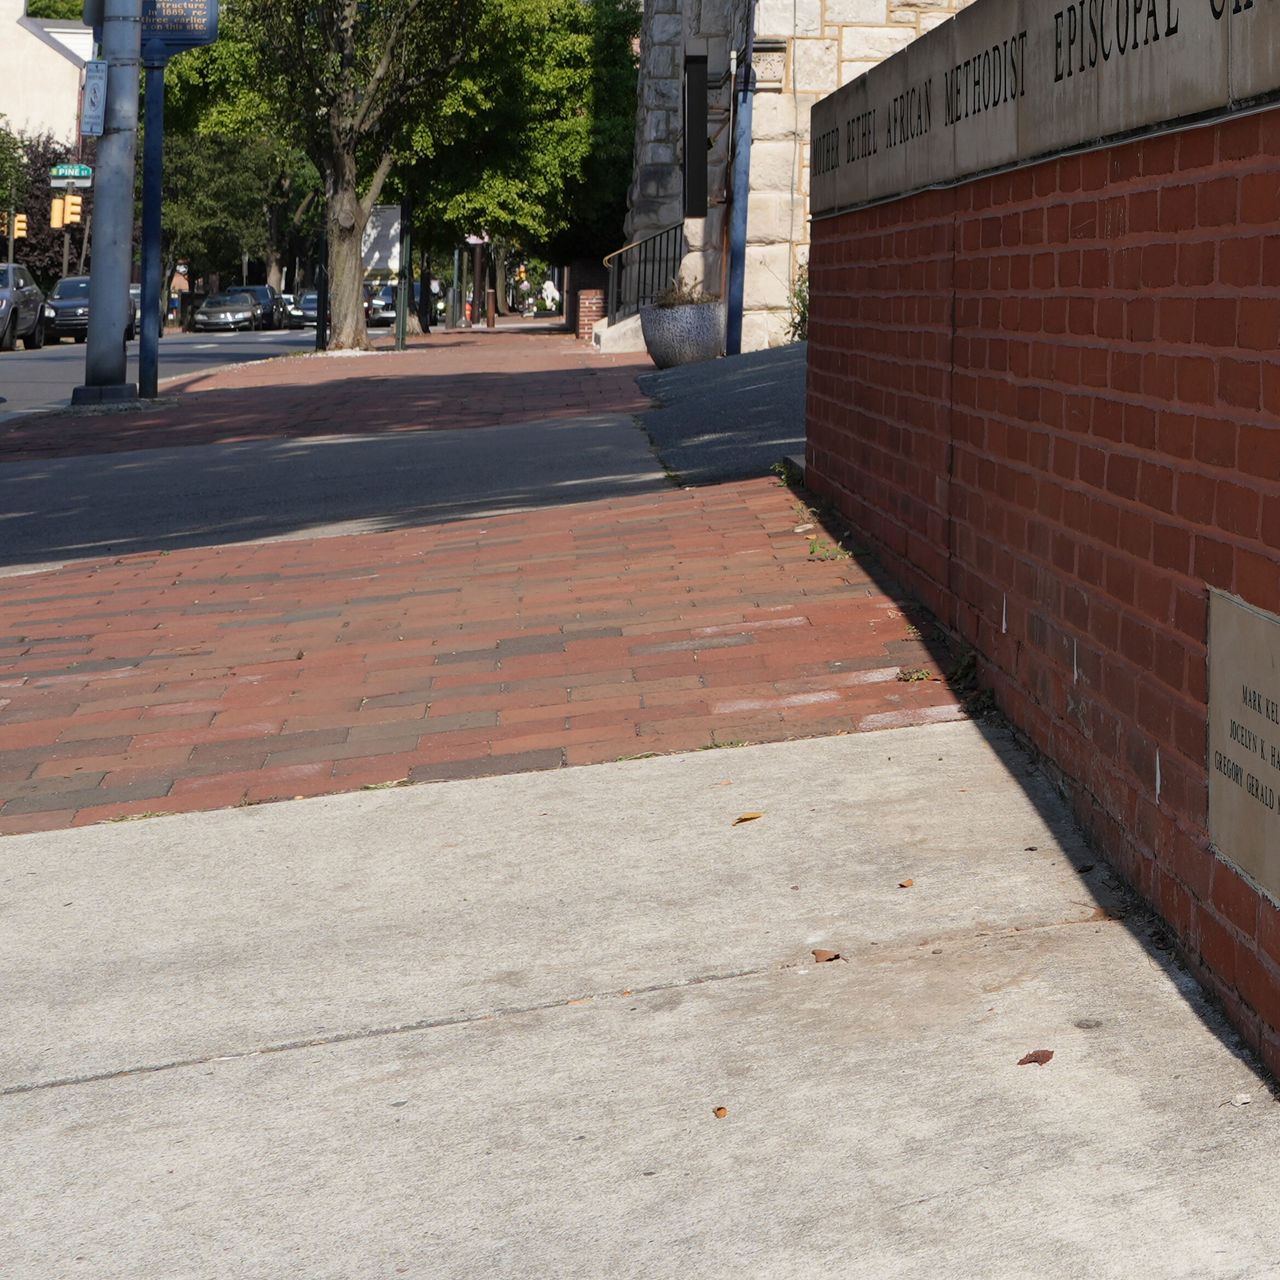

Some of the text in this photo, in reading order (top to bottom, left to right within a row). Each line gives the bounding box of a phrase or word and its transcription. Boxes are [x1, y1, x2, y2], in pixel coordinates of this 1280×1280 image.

[847, 109, 877, 163] BETHEL
[886, 79, 932, 149] AFRICAN
[945, 30, 1025, 126] METHODIST
[59, 168, 80, 176] PINE
[1242, 684, 1262, 714] MARK
[1230, 718, 1258, 753] JOCELYN
[1215, 750, 1243, 787] GREGORY
[1247, 773, 1275, 809] GERALD
